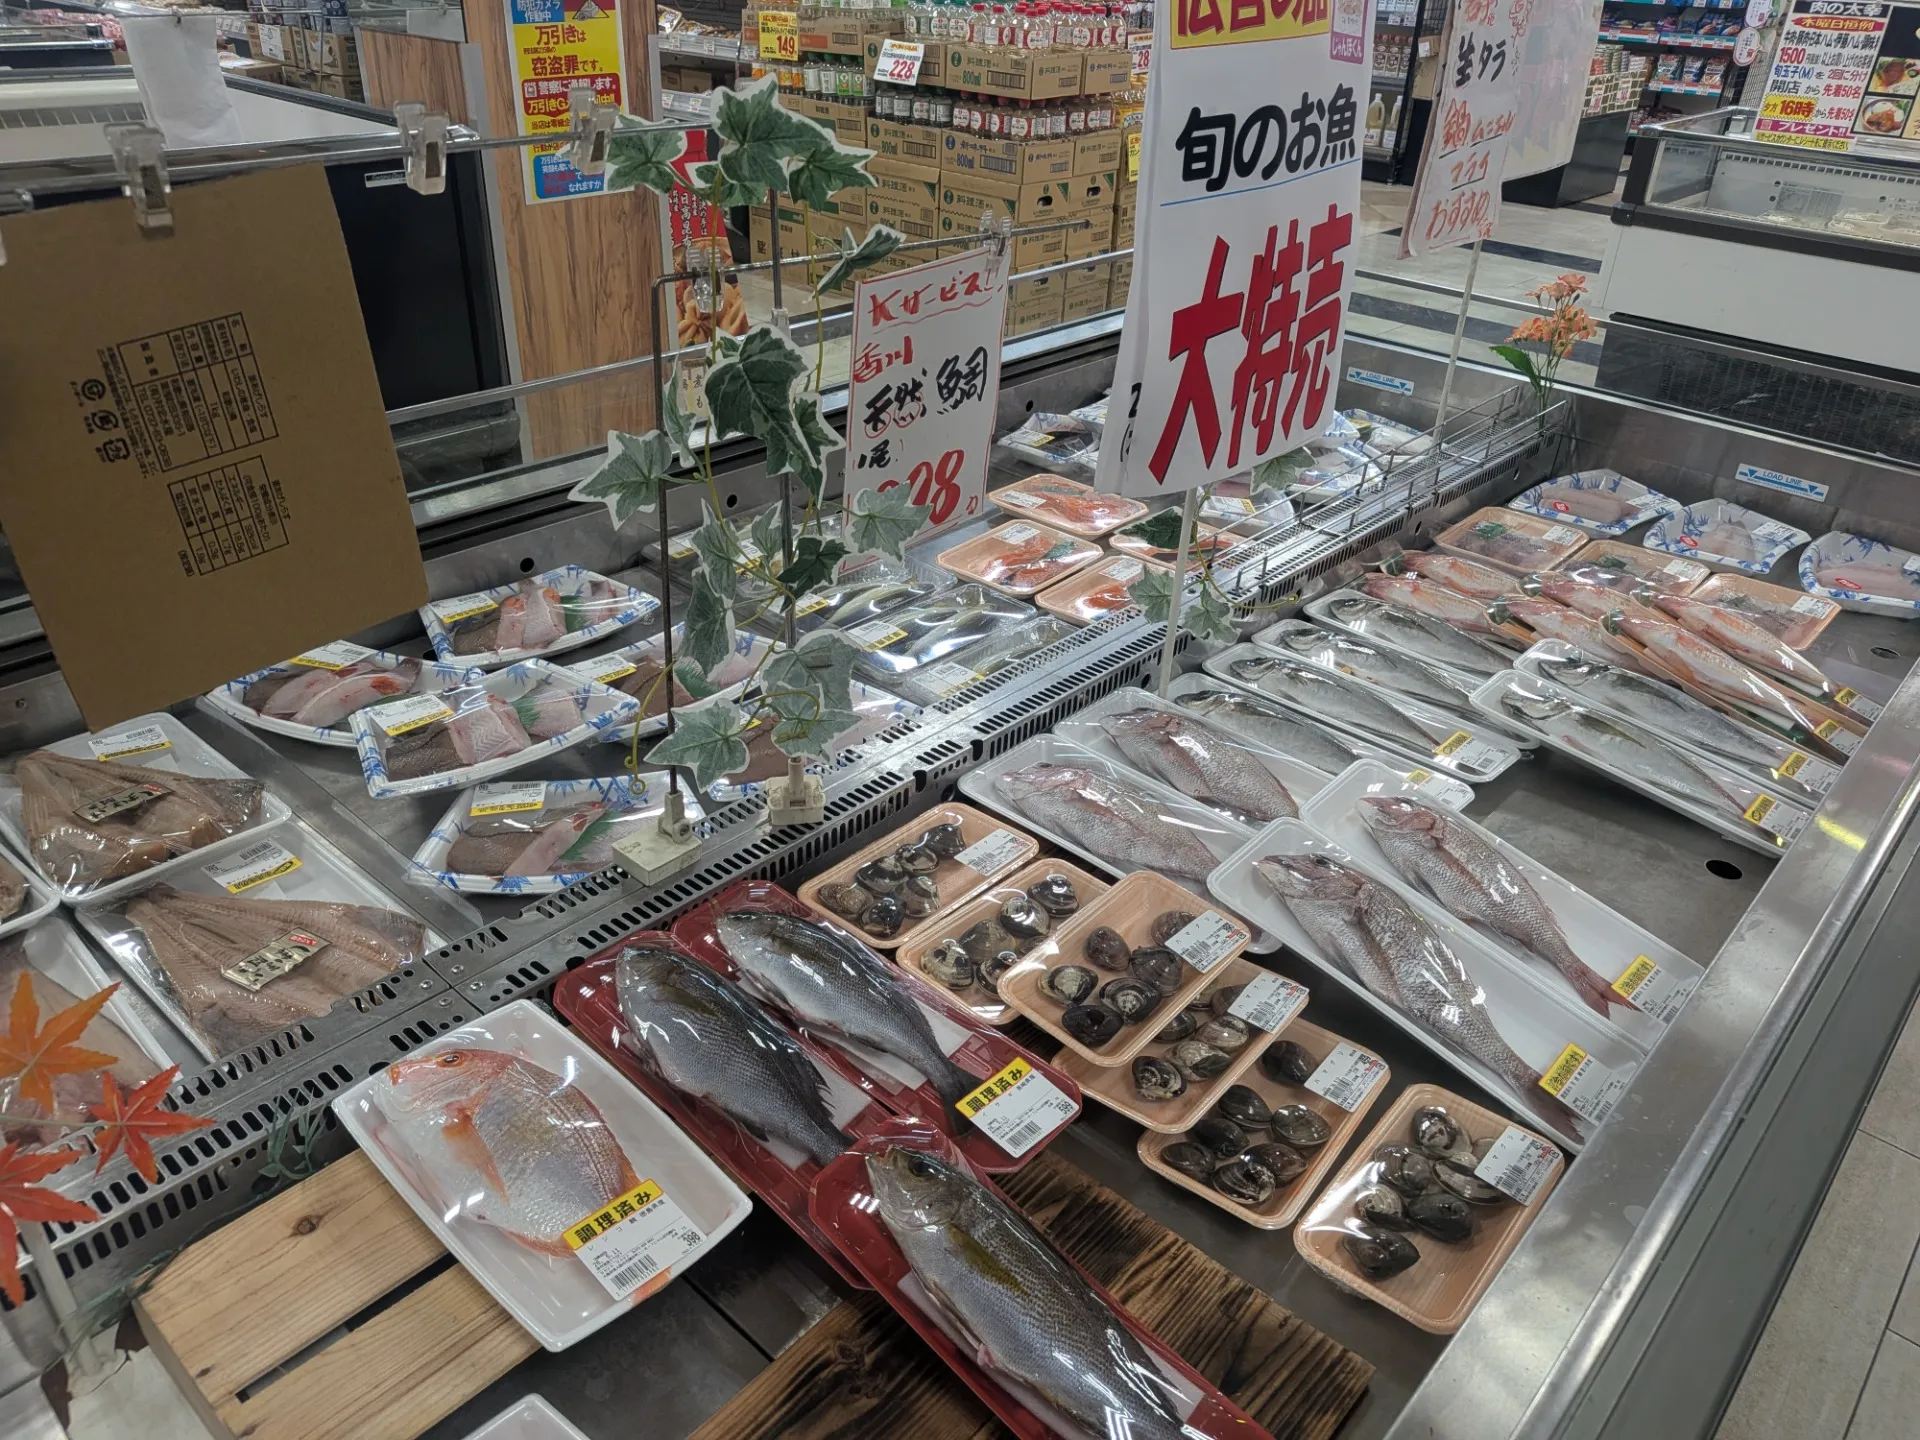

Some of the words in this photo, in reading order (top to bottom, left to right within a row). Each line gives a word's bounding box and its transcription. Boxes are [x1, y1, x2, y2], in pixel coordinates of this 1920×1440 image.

[524, 11, 552, 23] 作動中
[1802, 18, 1875, 30] 木曜日恒例
[535, 24, 587, 46] 万引きは
[777, 35, 795, 55] 149
[531, 54, 604, 77] 窃盗罪です。
[1456, 31, 1506, 88] 生タラ
[1779, 47, 1806, 64] 1500
[889, 59, 915, 79] 228
[1774, 64, 1814, 80] 旬玉子(M)
[1827, 69, 1868, 83] 2回に分け
[1769, 80, 1802, 95] 開店
[1804, 85, 1820, 95] から
[1821, 84, 1862, 99] 先着50名
[1763, 103, 1778, 113] 夕方
[1779, 100, 1814, 118] 16時
[1814, 108, 1827, 118] から
[1176, 83, 1357, 192] 旬のお魚
[1777, 121, 1847, 136] プレゼント!!
[1452, 151, 1491, 183] フライ
[1148, 203, 1352, 485] 大特売
[854, 335, 913, 384] 香川
[1762, 471, 1783, 480] LOAD
[1786, 477, 1802, 486] LINE
[966, 1069, 1022, 1112] 調理済み
[1059, 1102, 1073, 1114] 599
[575, 1192, 651, 1244] 調理済み
[683, 1230, 701, 1247] 398
